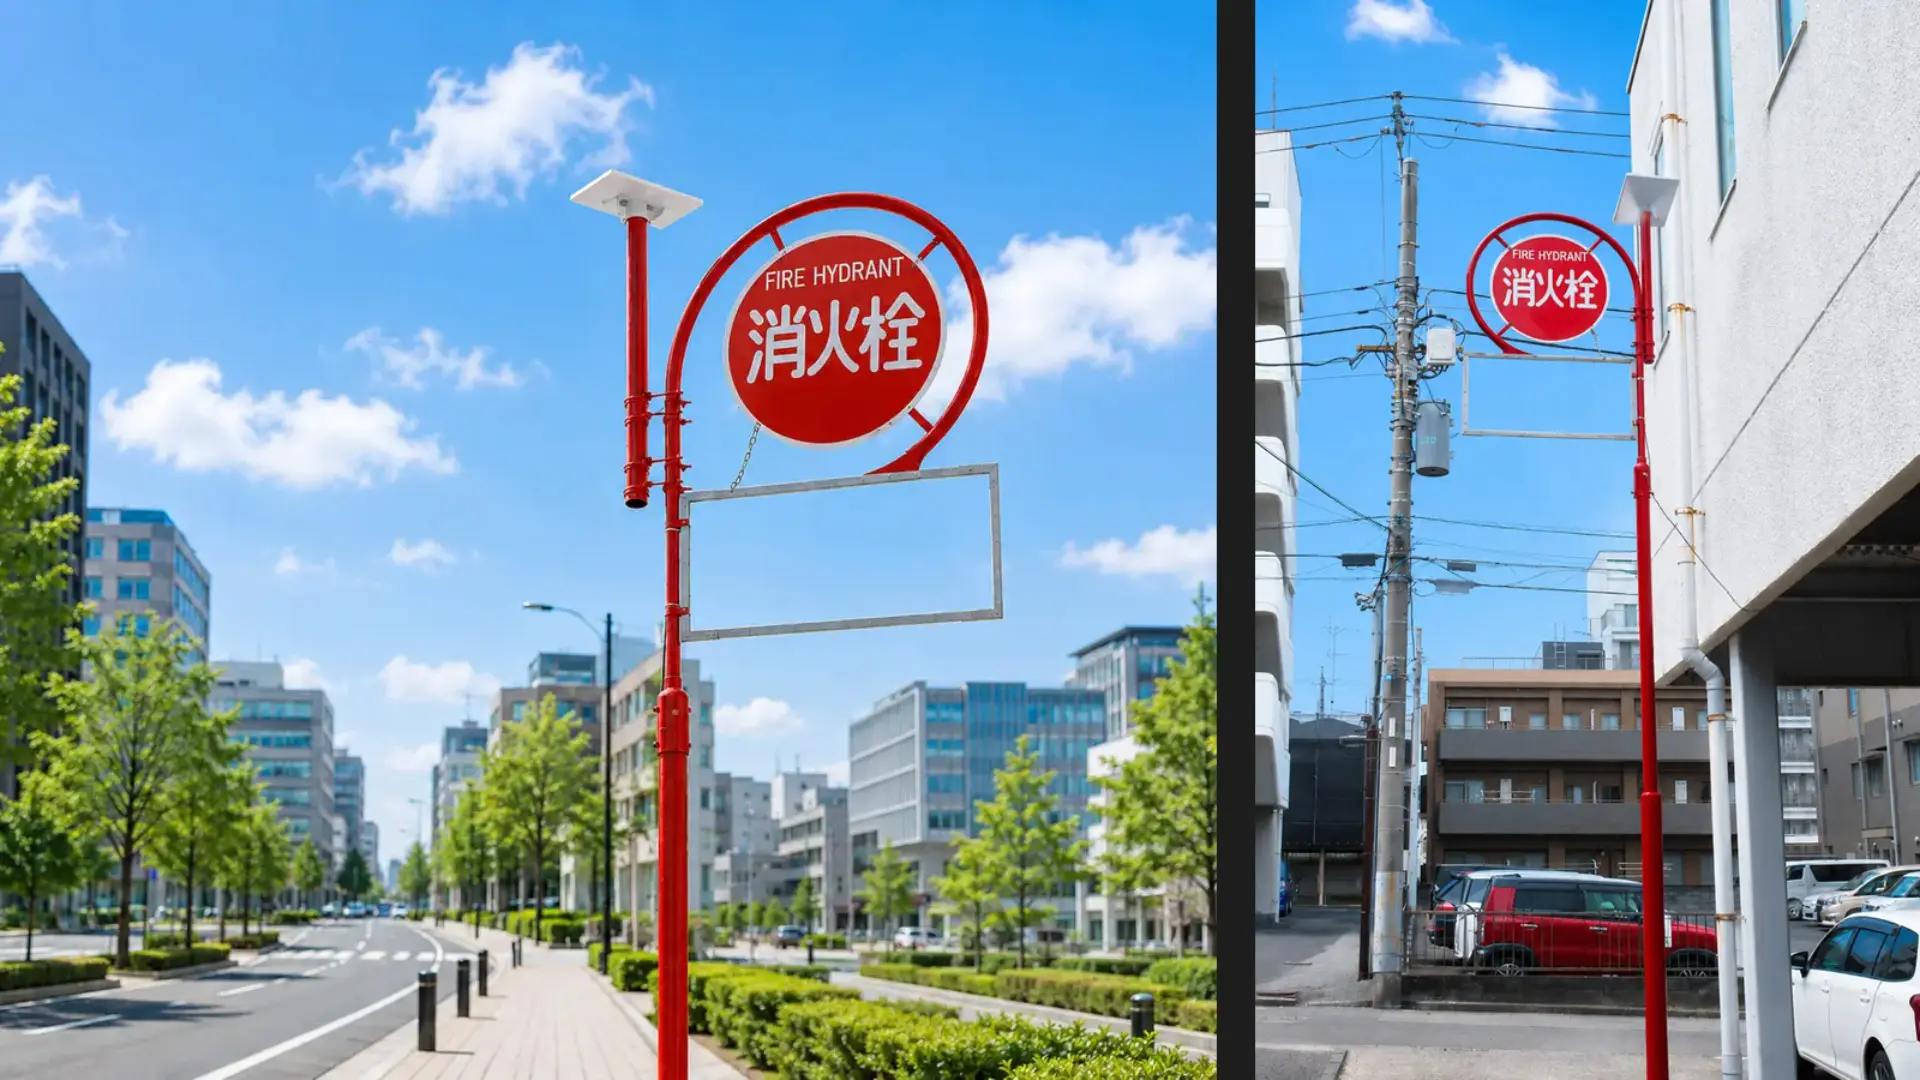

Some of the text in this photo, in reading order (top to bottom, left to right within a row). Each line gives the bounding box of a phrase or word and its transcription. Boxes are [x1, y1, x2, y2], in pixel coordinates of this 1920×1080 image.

[765, 256, 904, 291] FIRE HYDRANT
[1512, 249, 1589, 262] FIRE HYDRANT
[1502, 267, 1599, 309] 消火栓
[746, 291, 926, 384] 消火栓
